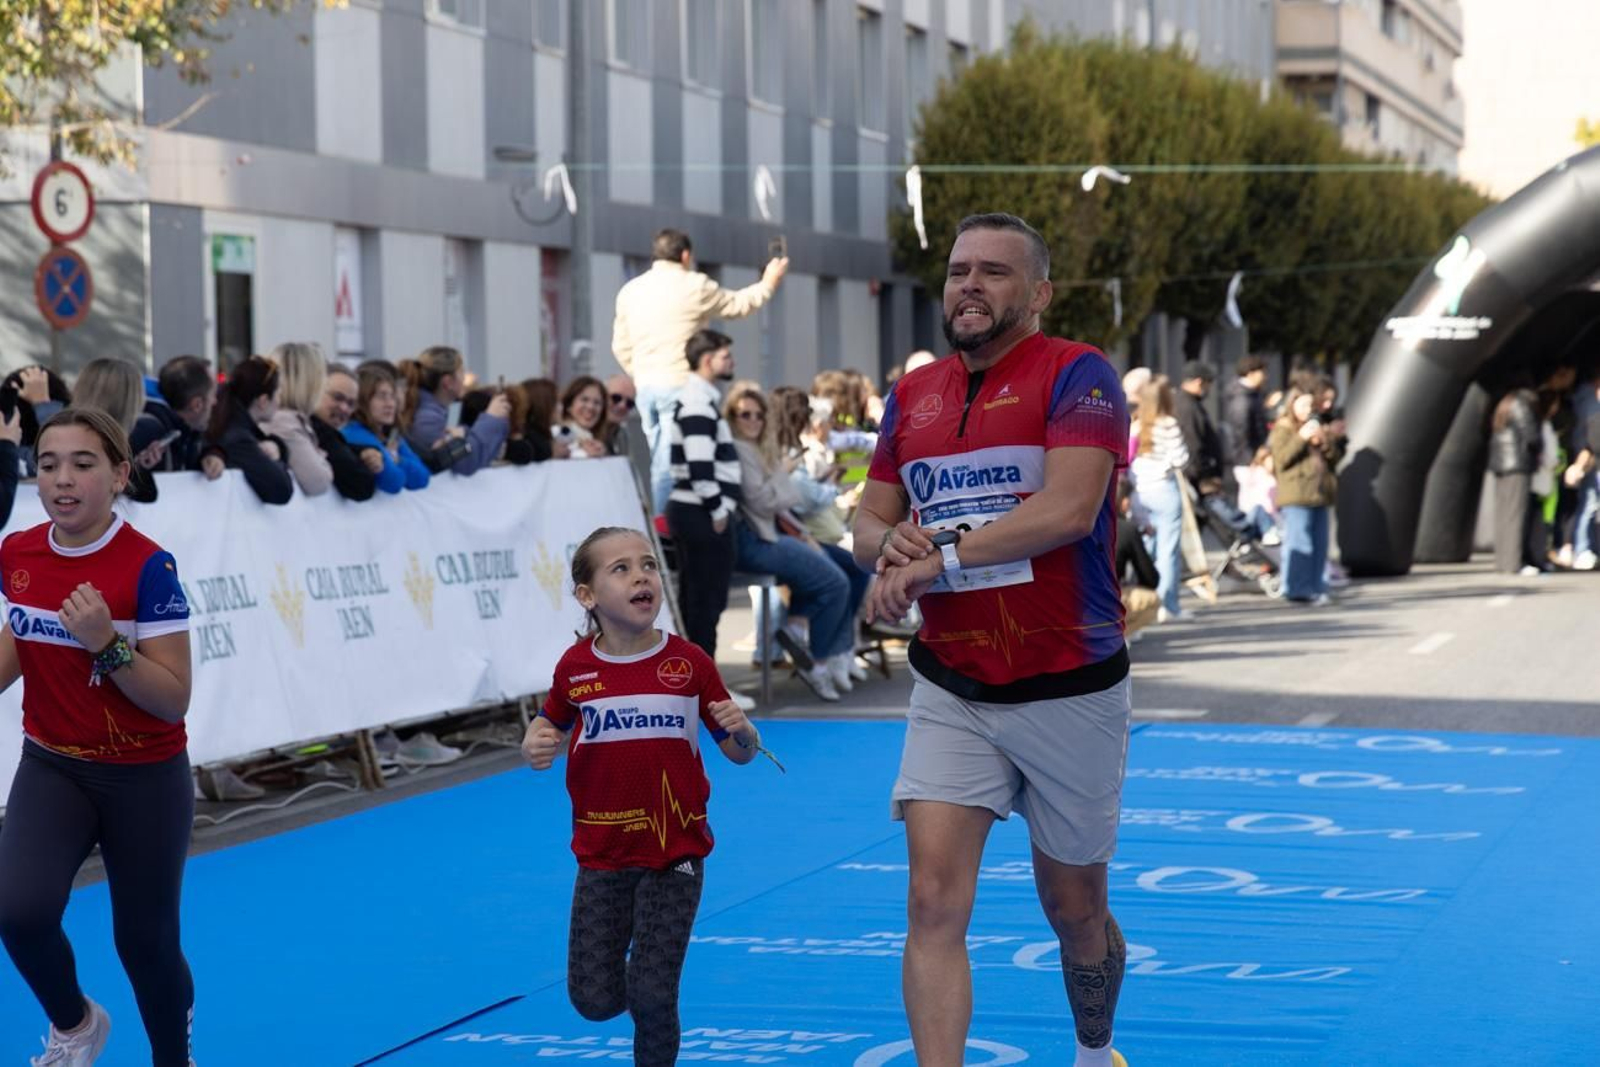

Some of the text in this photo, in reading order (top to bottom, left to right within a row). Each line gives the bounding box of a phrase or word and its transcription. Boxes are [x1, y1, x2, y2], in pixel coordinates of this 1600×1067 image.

[54, 186, 69, 218] 6
[938, 465, 1022, 492] Avanza
[196, 573, 258, 614] RURAL
[602, 708, 685, 732] Avanza
[617, 706, 640, 716] GRUPO
[443, 1032, 826, 1055] MAATÓN
